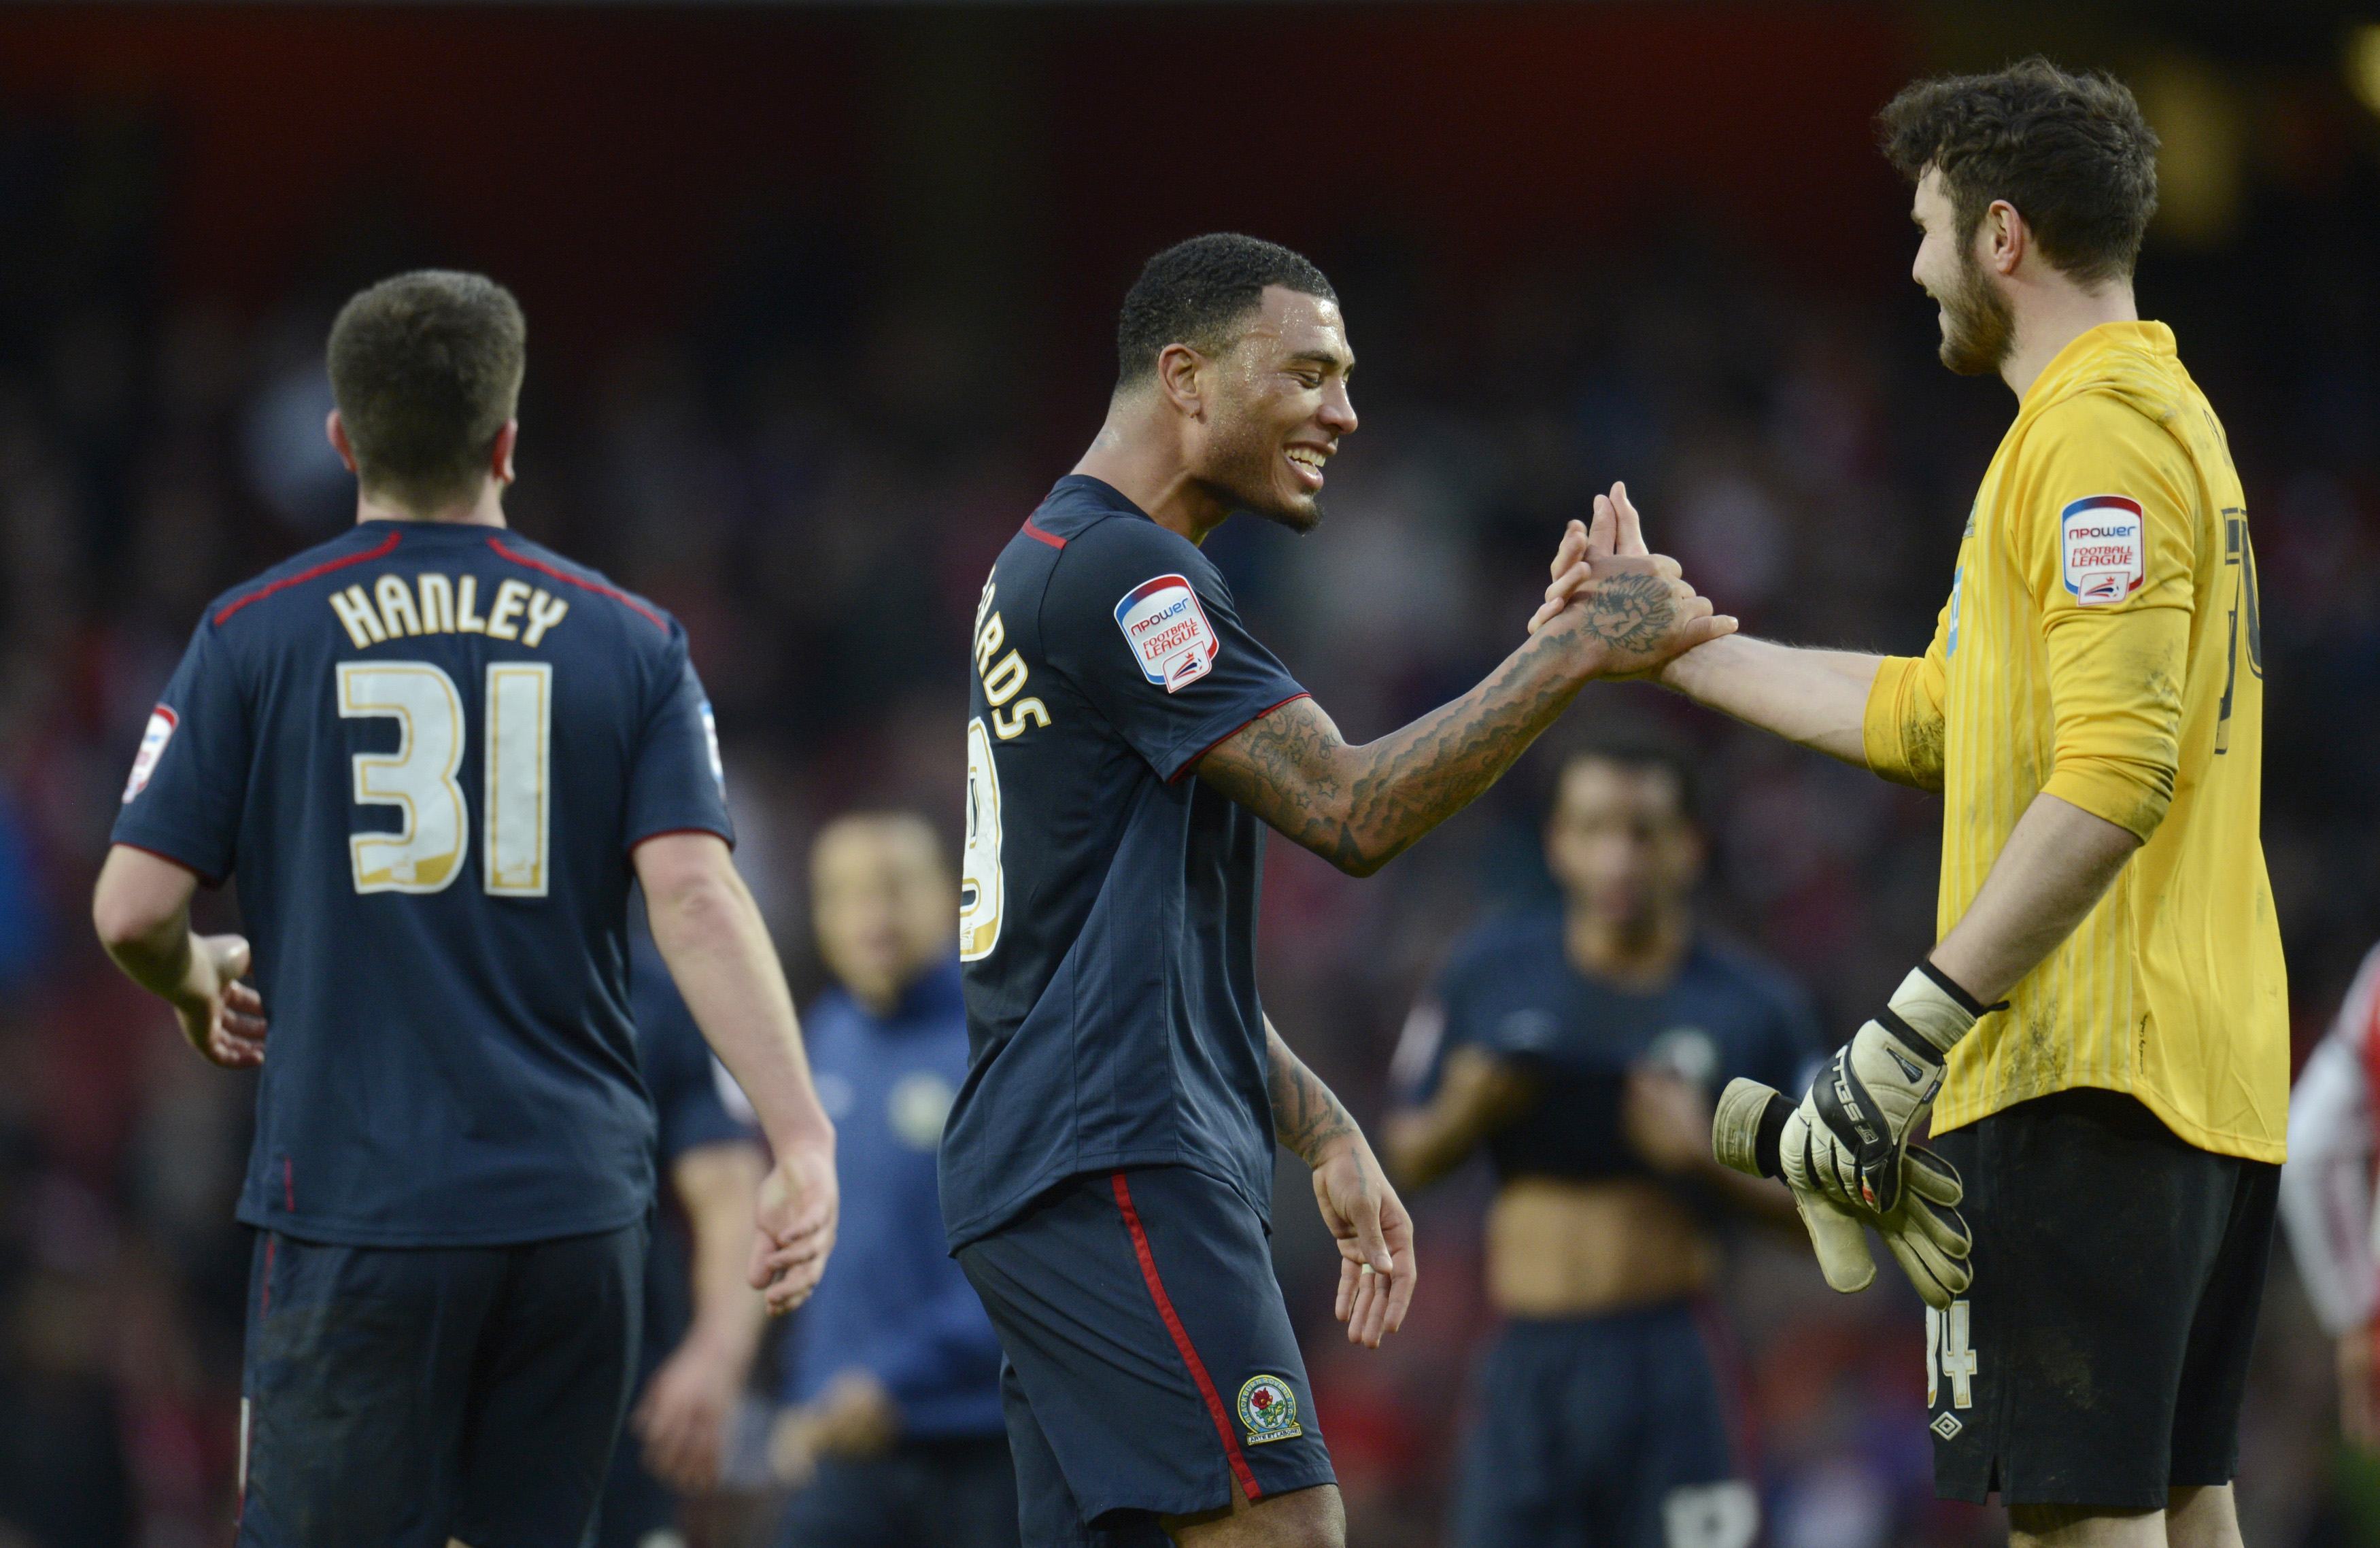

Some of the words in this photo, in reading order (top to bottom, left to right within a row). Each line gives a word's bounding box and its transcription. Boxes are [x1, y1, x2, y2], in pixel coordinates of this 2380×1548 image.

[2069, 526, 2137, 540] npower
[2073, 545, 2132, 555] FOOTBALL
[2072, 554, 2132, 568] LEAGUE
[328, 572, 570, 649] HANLEY
[1130, 598, 1189, 636] npower
[1143, 617, 1197, 650] FOOTBALL
[1145, 625, 1200, 661] LEAGUE
[974, 564, 1052, 740] ARDS
[336, 660, 553, 897] 31
